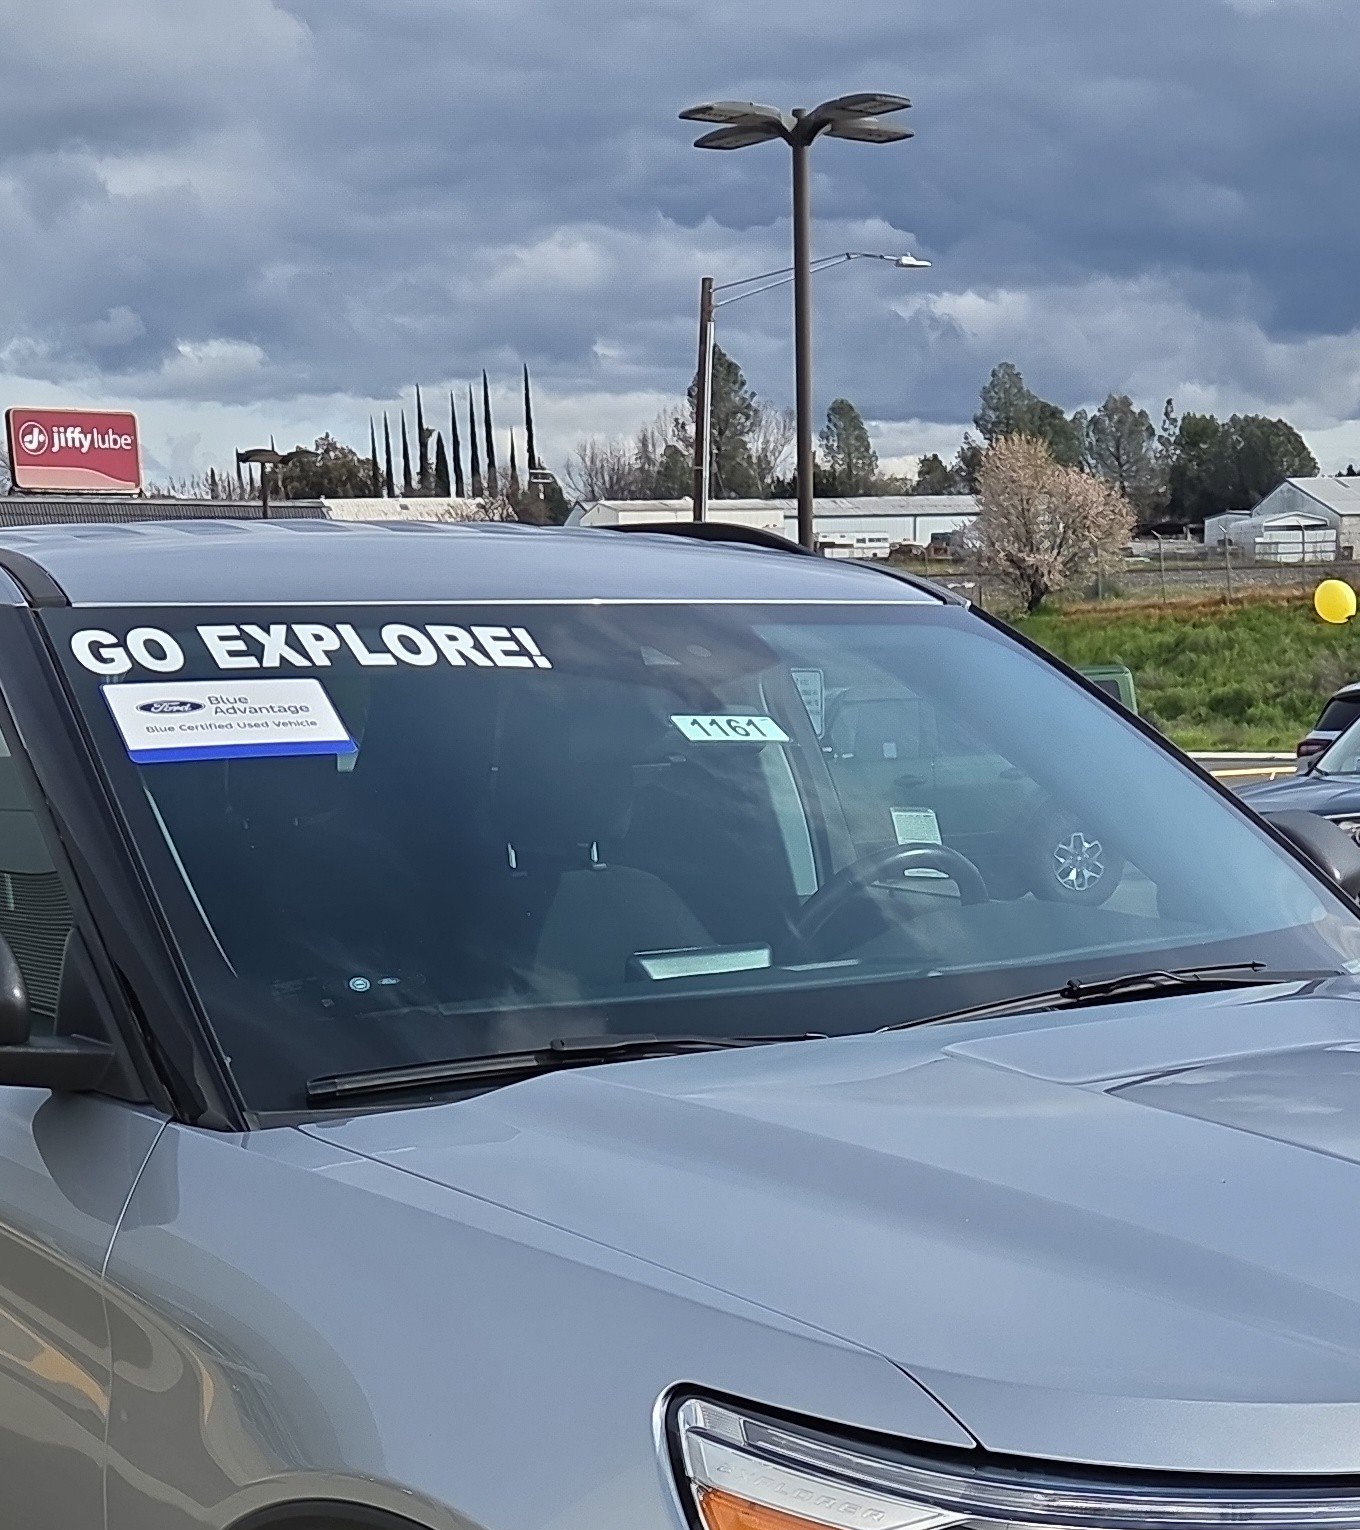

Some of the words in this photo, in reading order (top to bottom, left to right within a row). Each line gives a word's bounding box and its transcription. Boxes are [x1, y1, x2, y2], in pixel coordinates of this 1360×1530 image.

[70, 627, 185, 675] GO
[196, 623, 553, 669] EXPLORE!
[207, 695, 249, 706] Blue
[214, 704, 310, 716] Advantage
[145, 724, 175, 734] Blue
[178, 721, 233, 733] Certified
[236, 719, 269, 730] Used
[272, 718, 318, 729] Vehicle
[690, 718, 767, 737] 1161
